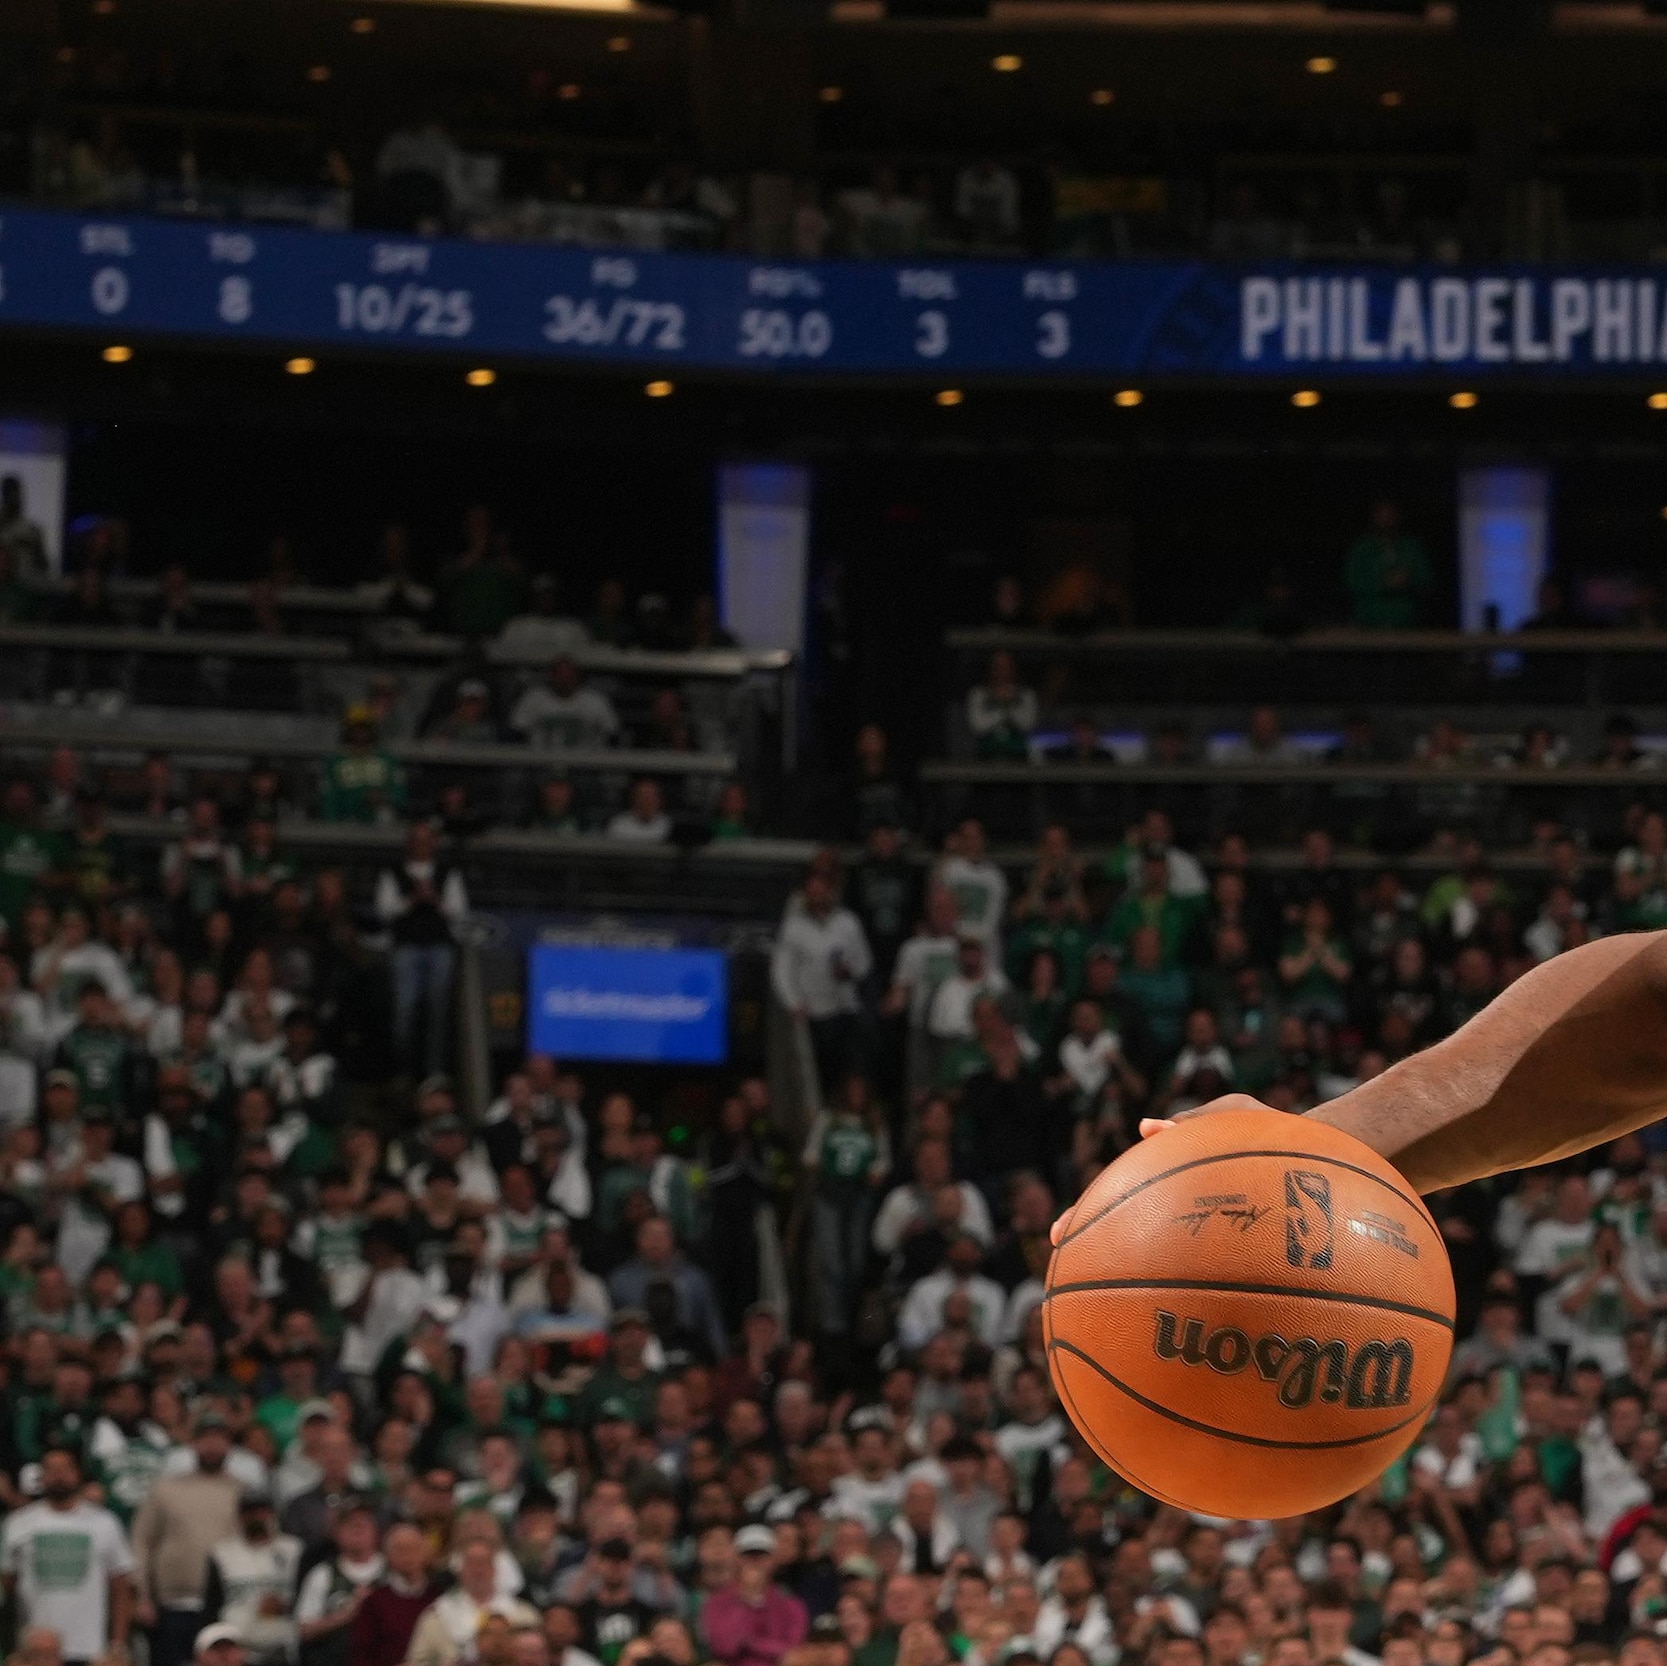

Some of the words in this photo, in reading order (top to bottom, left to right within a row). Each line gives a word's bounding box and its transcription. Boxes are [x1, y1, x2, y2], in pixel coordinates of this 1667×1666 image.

[91, 266, 129, 314] 0
[219, 276, 252, 323] 8
[336, 283, 473, 337] 10/25
[544, 295, 685, 350] 36/72
[737, 308, 832, 357] 50.0
[916, 310, 949, 358] 3
[1037, 311, 1070, 358] 3
[1154, 1309, 1414, 1410] Wilson
